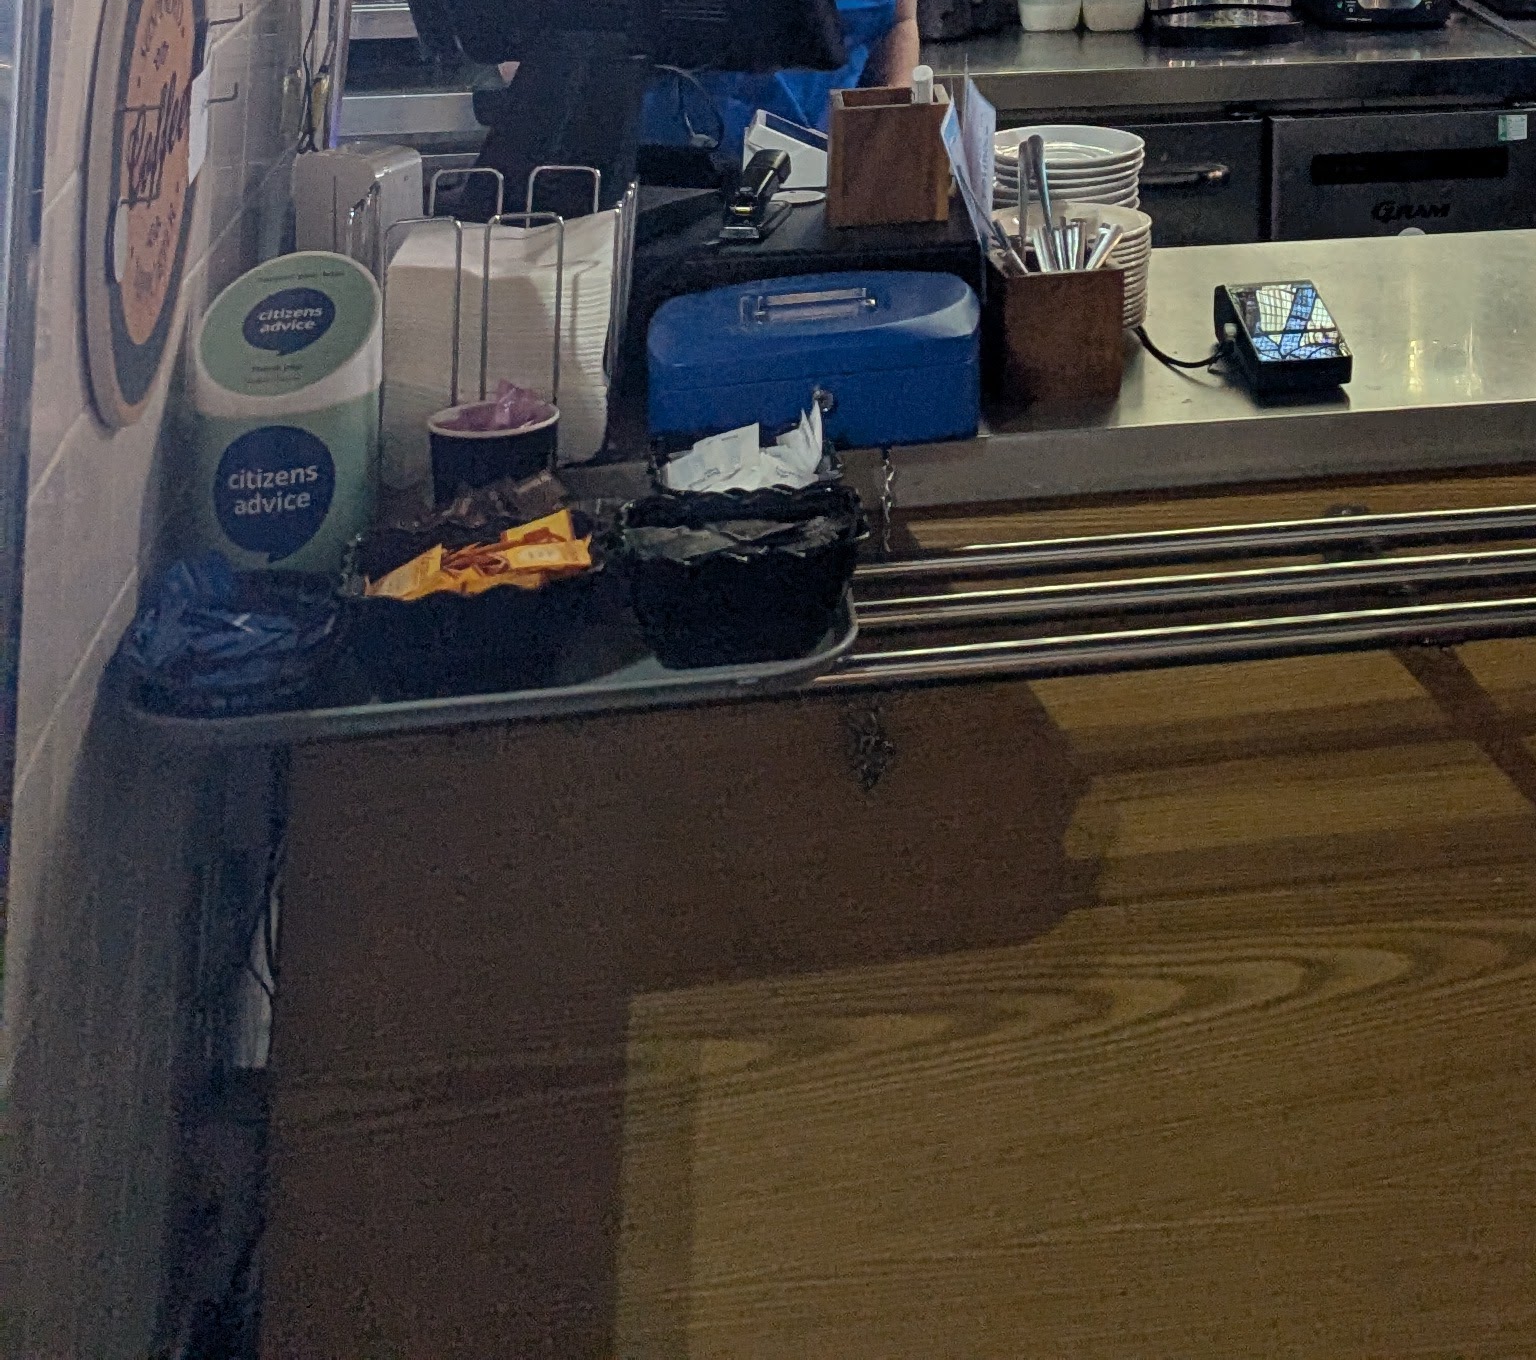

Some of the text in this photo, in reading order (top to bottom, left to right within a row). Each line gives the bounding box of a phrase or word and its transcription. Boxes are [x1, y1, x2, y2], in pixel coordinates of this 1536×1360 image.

[258, 306, 323, 321] citizens
[259, 319, 316, 334] advice
[227, 464, 318, 491] citizens
[234, 491, 311, 516] advice
